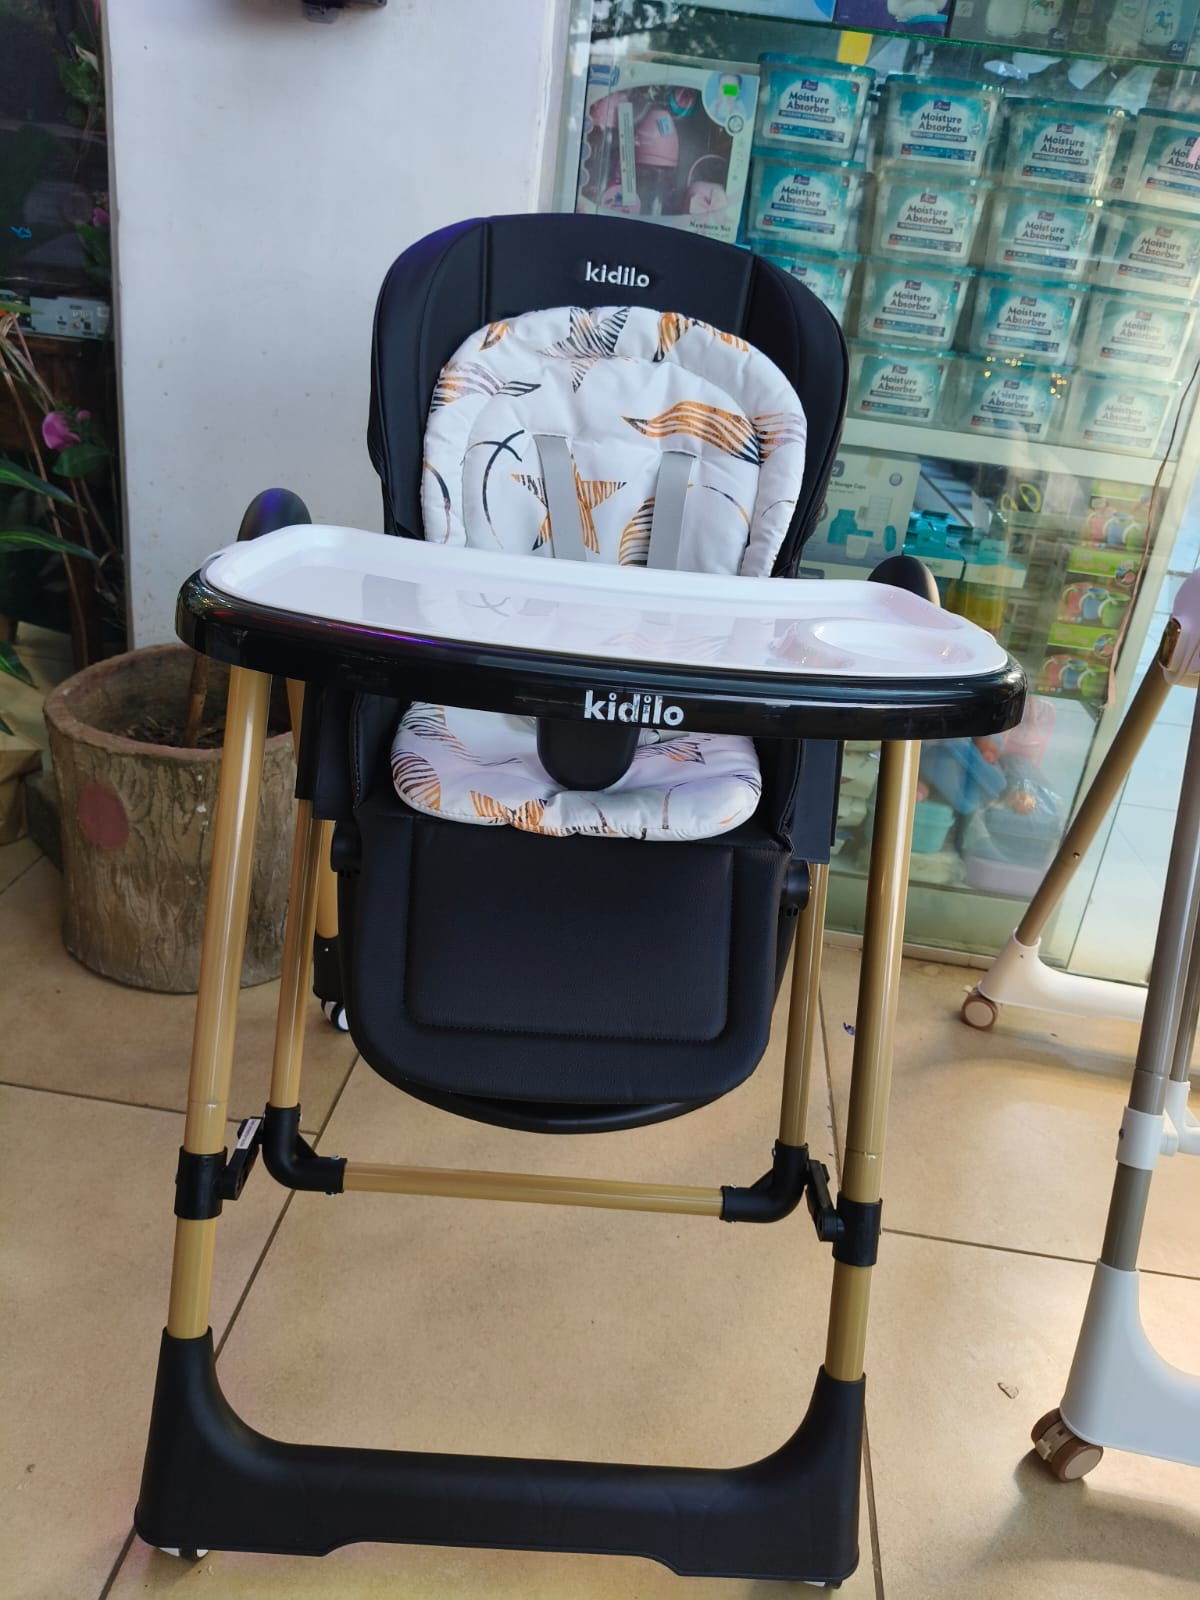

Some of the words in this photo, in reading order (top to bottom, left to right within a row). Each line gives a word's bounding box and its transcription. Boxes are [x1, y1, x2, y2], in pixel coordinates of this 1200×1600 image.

[789, 91, 829, 105] Moisture
[787, 101, 829, 114] Absorber
[921, 112, 962, 124] Moisture
[918, 121, 961, 133] Absorber
[1043, 134, 1085, 147] Moisture
[1040, 144, 1084, 157] Absorber
[781, 186, 821, 198] Moisture
[778, 194, 820, 207] Absorber
[908, 205, 948, 217] Moisture
[905, 212, 947, 226] Absorber
[1025, 221, 1065, 234] Moisture
[1022, 230, 1064, 243] Absorber
[1141, 237, 1181, 251] Moisture
[1138, 245, 1180, 260] Absorber
[585, 261, 650, 287] kidilo
[893, 291, 932, 303] Moisture
[890, 299, 930, 311] Absorber
[1008, 306, 1047, 319] Moisture
[1004, 315, 1046, 328] Absorber
[880, 374, 918, 386] Moisture
[877, 382, 917, 395] Absorber
[988, 397, 1028, 410] Absorber
[584, 689, 684, 726] kidilo
